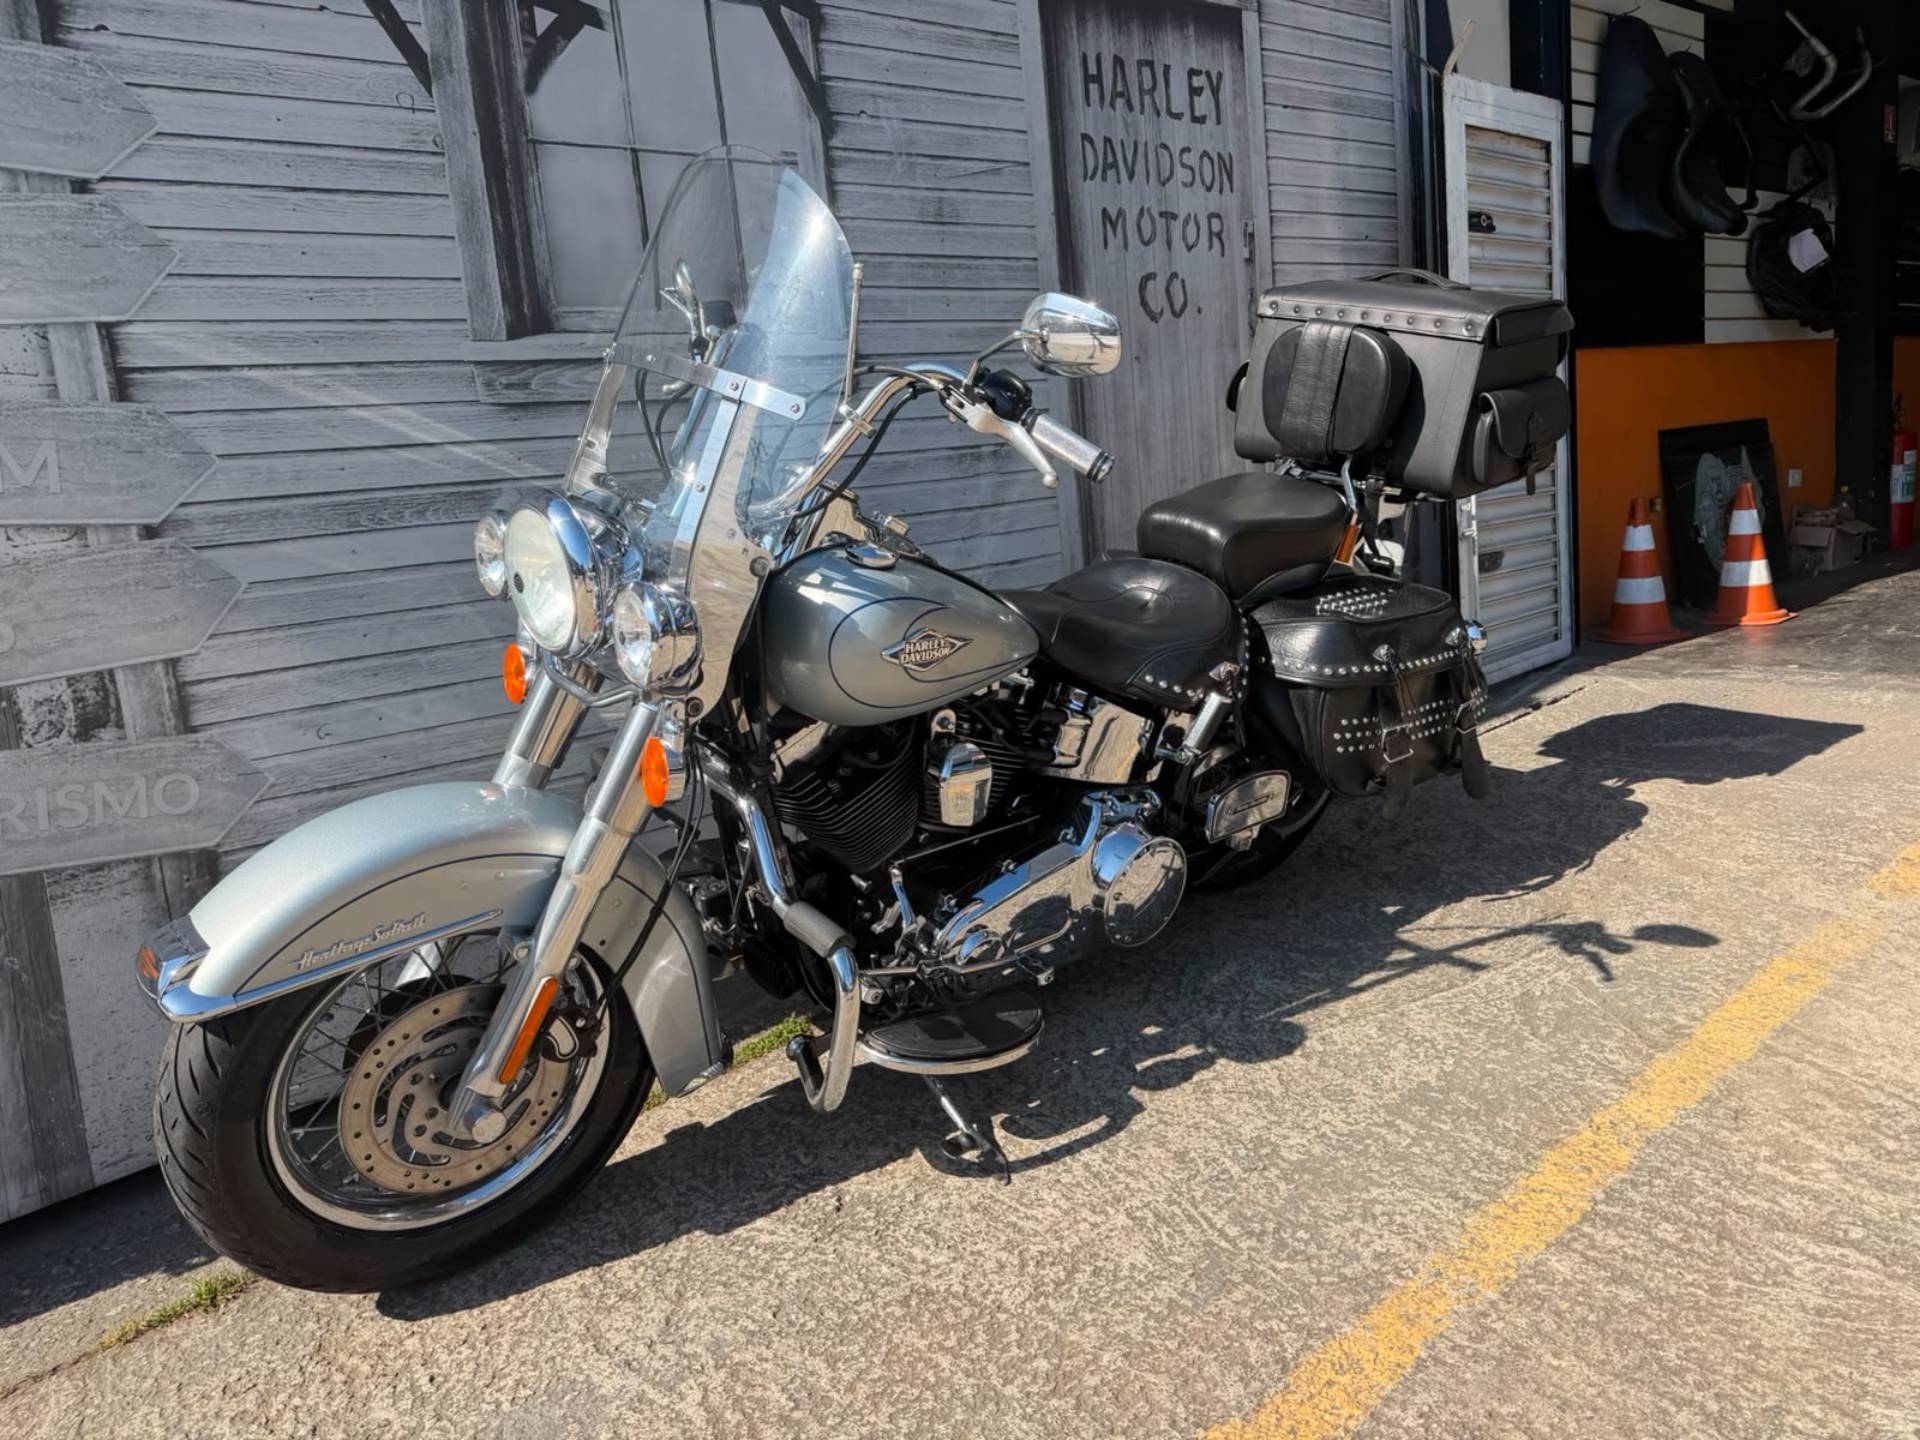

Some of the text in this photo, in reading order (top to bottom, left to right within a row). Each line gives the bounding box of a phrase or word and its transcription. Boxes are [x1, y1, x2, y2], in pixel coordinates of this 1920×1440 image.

[1081, 51, 1223, 126] HARLEY
[1080, 132, 1234, 195] DAVIDSON
[1101, 205, 1225, 258] MOTOR
[1138, 271, 1203, 324] CO.
[901, 646, 951, 664] DAVIDSON
[905, 638, 945, 654] HARLEY
